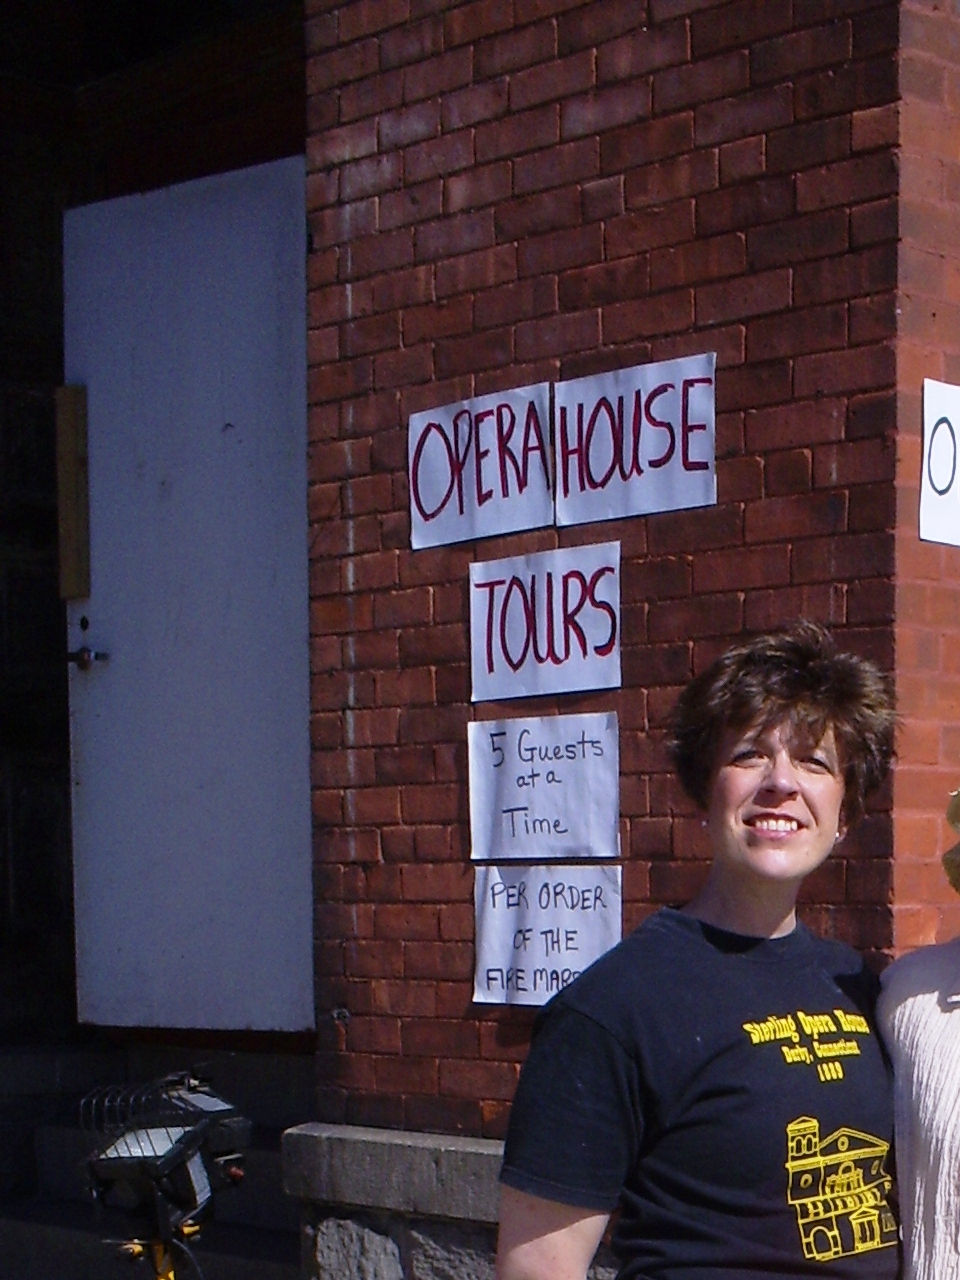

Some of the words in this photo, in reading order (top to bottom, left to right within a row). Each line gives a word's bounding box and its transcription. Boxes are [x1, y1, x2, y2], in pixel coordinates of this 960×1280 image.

[411, 399, 550, 522] OPERA
[560, 377, 713, 499] HOUSE
[474, 566, 617, 675] TOURS
[490, 731, 507, 768] 5
[517, 729, 604, 763] Guests
[516, 767, 541, 788] at
[546, 769, 562, 784] a
[502, 806, 568, 837] Time
[490, 881, 529, 910] PER
[538, 881, 608, 911] ORDER
[513, 928, 533, 950] OF
[540, 926, 579, 957] THE
[486, 968, 528, 992] FIRE
